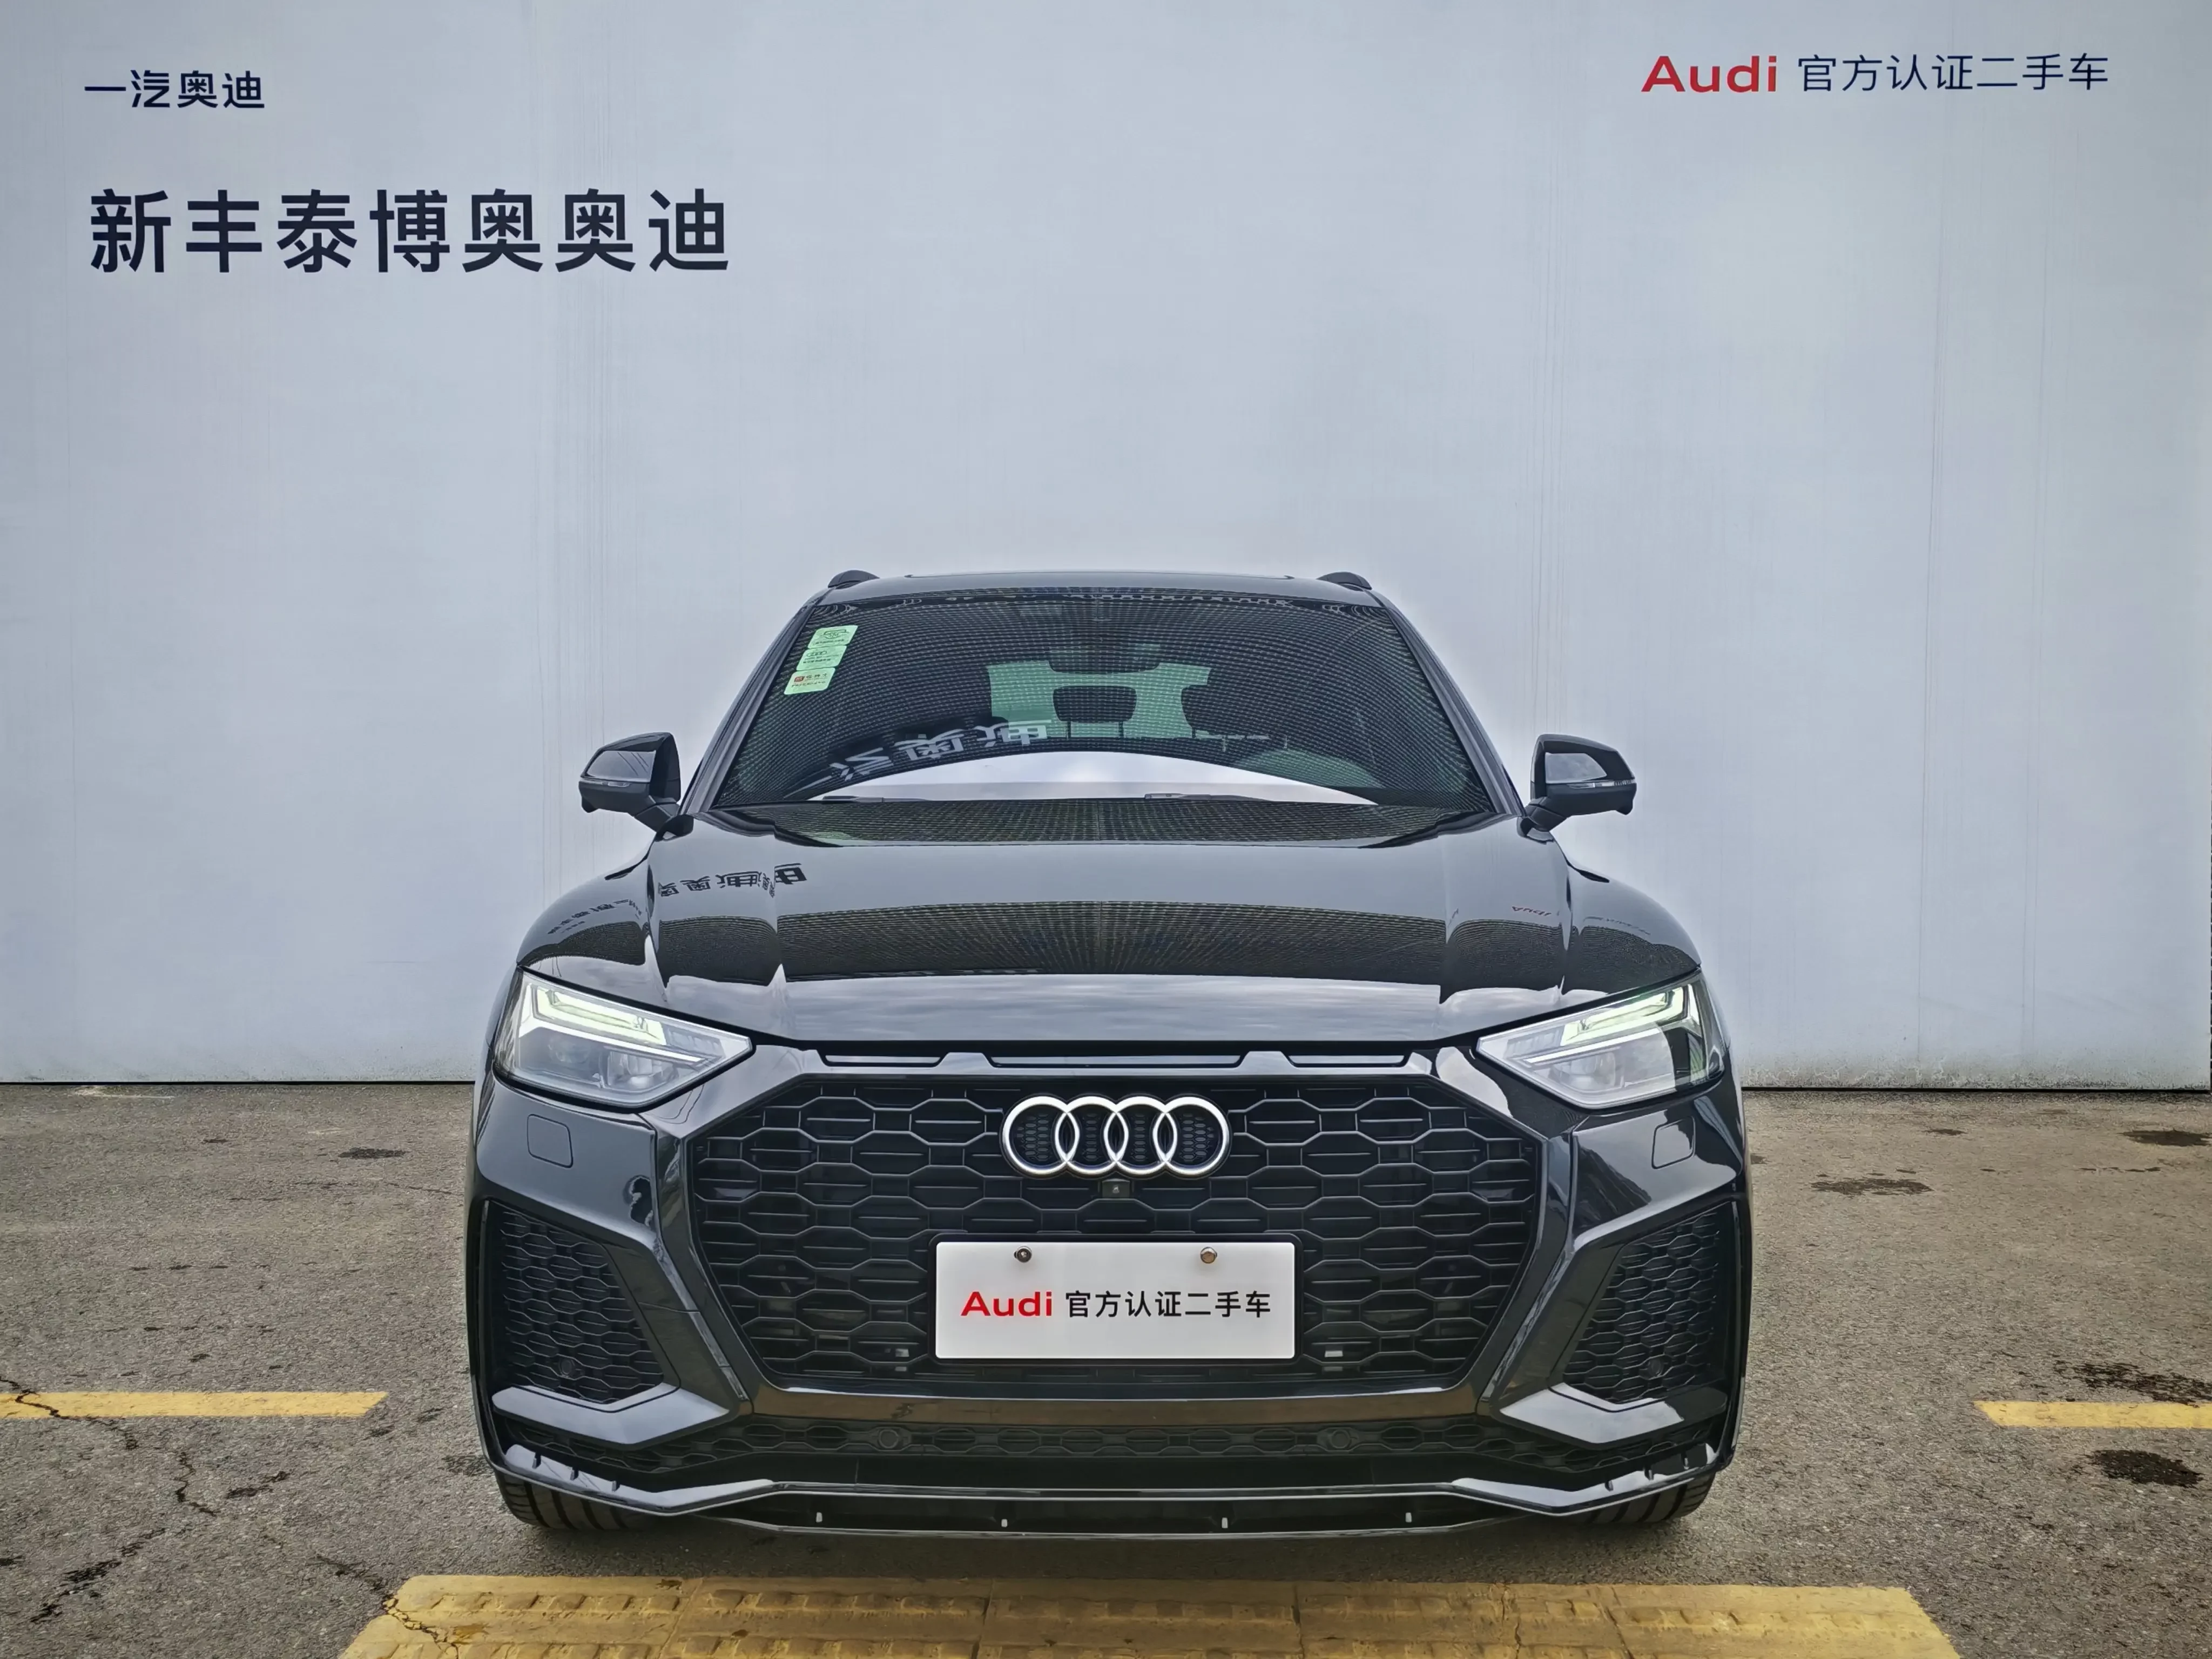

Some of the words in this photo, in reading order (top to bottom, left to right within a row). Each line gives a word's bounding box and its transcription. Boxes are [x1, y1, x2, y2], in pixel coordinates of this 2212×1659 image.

[84, 69, 265, 109] 一汽奥迪
[1641, 55, 1776, 93] Audi
[1798, 52, 2109, 92] 官方认证二手车
[90, 187, 729, 273] 新丰泰博奥奥迪
[959, 1290, 1053, 1318] Audi
[1065, 1290, 1271, 1318] 官方认证二手车
